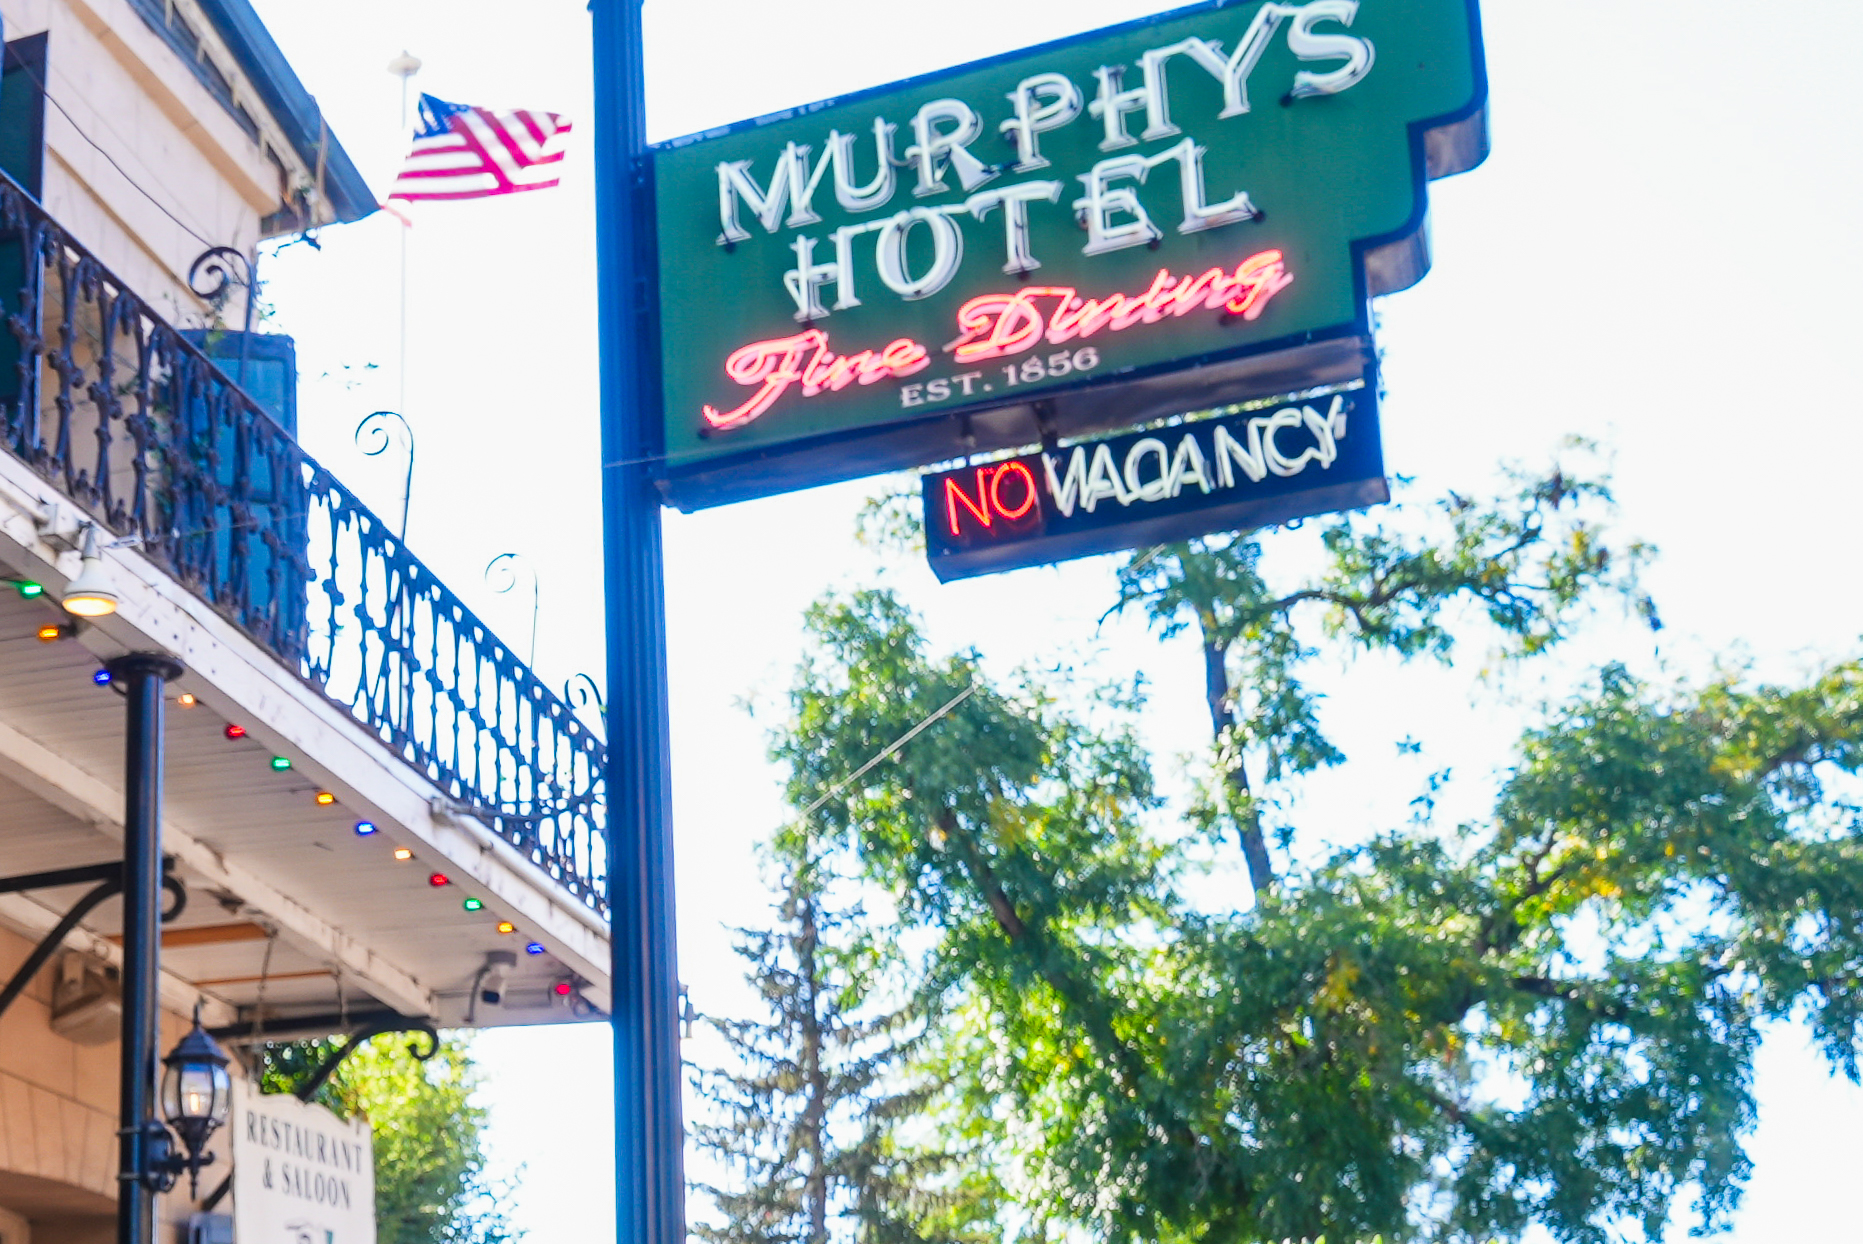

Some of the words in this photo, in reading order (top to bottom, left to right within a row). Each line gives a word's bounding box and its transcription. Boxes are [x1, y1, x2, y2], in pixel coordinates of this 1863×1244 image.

[715, 1, 1375, 245] MURPHYS
[784, 138, 1266, 321] HOTEL
[702, 330, 931, 430] Fine
[948, 249, 1294, 364] Dining
[900, 371, 994, 408] EST.
[1002, 346, 1101, 387] 1856
[943, 460, 1038, 537] NO
[1041, 394, 1348, 518] VACANCY
[247, 1110, 361, 1175] RESTAURANT
[262, 1157, 274, 1190] &
[281, 1165, 350, 1209] SALOON
